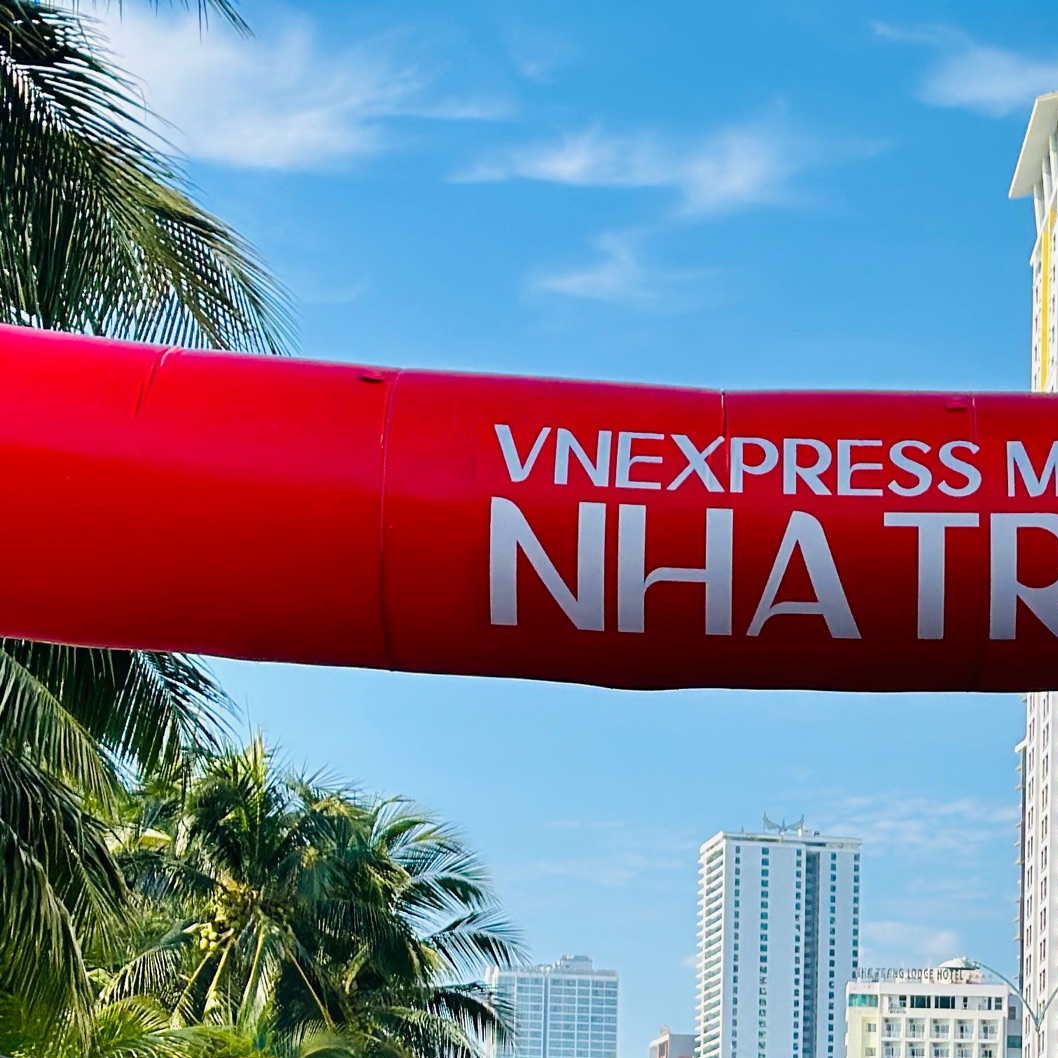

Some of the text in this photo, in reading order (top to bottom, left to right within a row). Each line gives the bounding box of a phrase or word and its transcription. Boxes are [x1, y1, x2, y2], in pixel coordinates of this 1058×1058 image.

[494, 424, 982, 497] VNEXPRESS
[489, 496, 862, 639] NHA
[907, 968, 934, 979] LODGE
[937, 968, 963, 980] HOTEL
